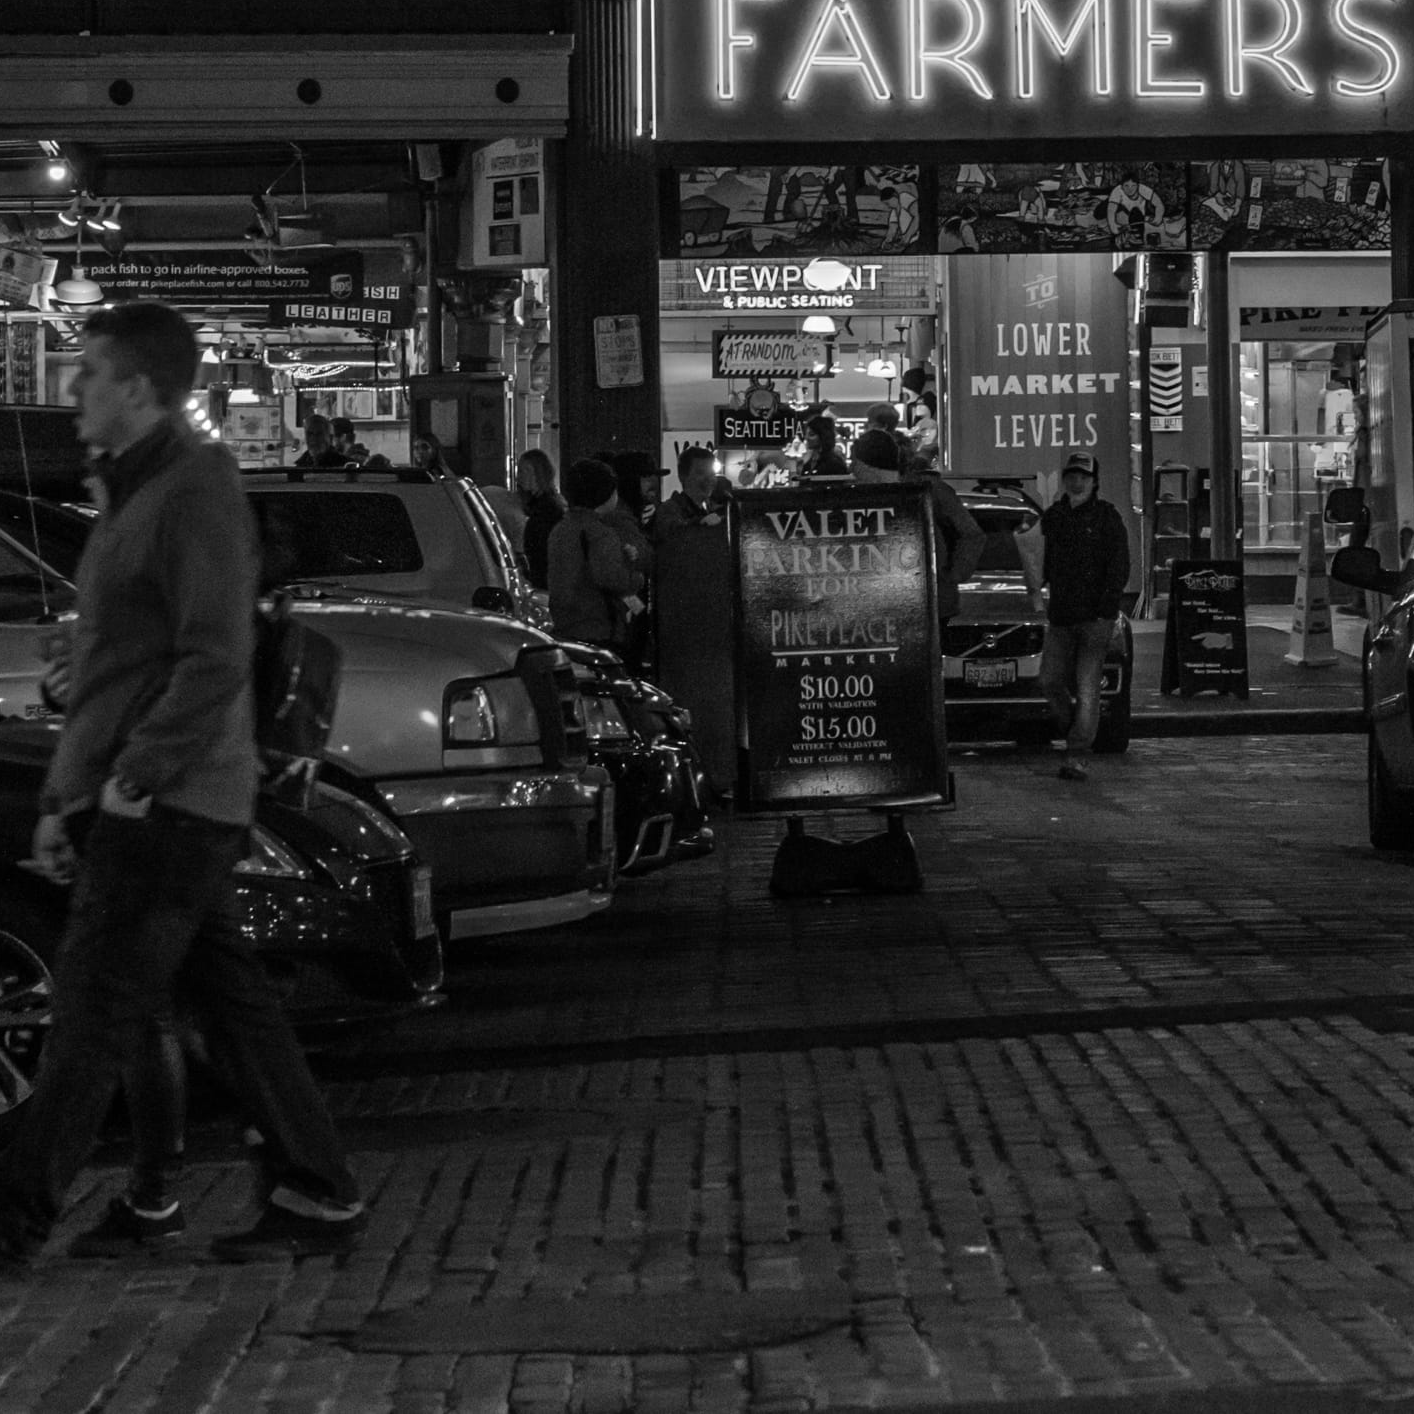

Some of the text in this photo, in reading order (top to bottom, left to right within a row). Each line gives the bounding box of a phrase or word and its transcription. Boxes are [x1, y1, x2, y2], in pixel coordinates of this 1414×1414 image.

[90, 264, 117, 278] pack
[119, 263, 138, 275] fish
[140, 265, 151, 275] to
[154, 267, 169, 278] go
[170, 264, 181, 275] in
[183, 263, 272, 278] airline-approved
[273, 265, 309, 275] boxes.
[694, 264, 883, 293] VIEWPNT
[116, 278, 139, 288] order
[140, 279, 150, 288] at
[237, 278, 253, 288] call
[1025, 280, 1055, 302] TO
[722, 294, 854, 309] & PUBLIC SEATING
[287, 304, 391, 324] LEATHER
[996, 322, 1092, 357] LOWER
[970, 372, 1122, 397] MARKET
[724, 417, 782, 439] SEATTLE
[993, 412, 1099, 448] LEVELS
[764, 507, 896, 540] VALET
[743, 542, 922, 578] PARKING
[804, 576, 861, 598] FOR
[771, 609, 898, 647] PIKE PLACE
[775, 652, 897, 669] MARKET
[799, 674, 874, 701] $10.00
[798, 699, 878, 711] WITH VALIDATION
[800, 715, 877, 742] $15.00
[792, 738, 888, 751] WITHOUT VALIDATION
[788, 755, 814, 765] VALET
[818, 753, 849, 763] CLOSES
[853, 753, 864, 762] AT
